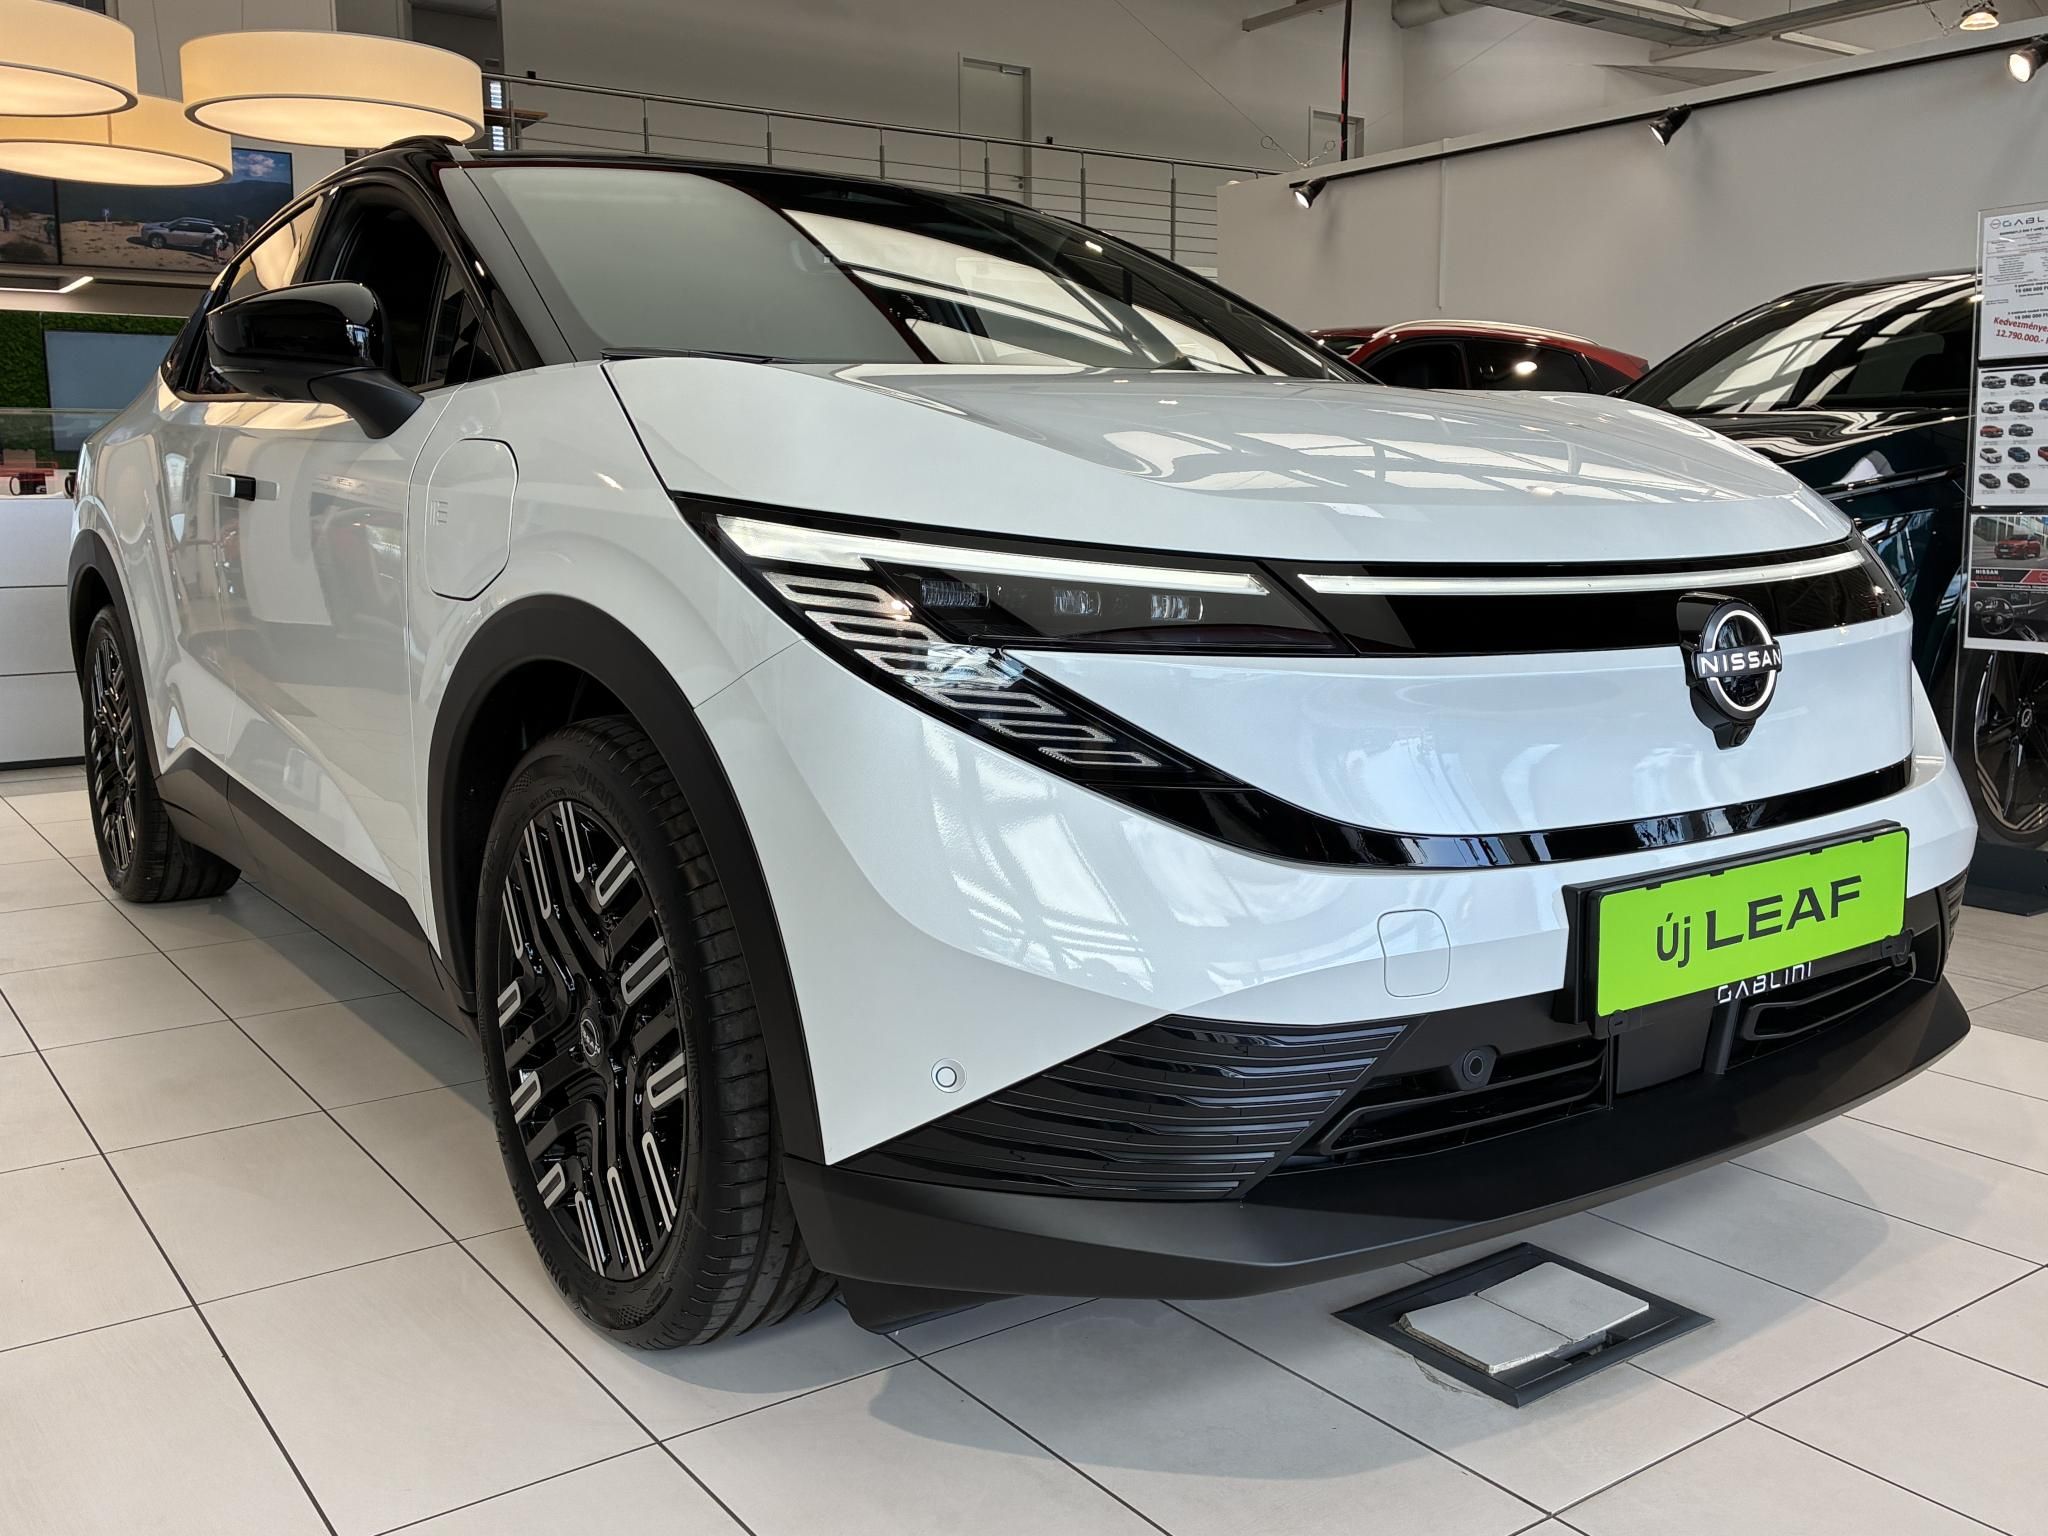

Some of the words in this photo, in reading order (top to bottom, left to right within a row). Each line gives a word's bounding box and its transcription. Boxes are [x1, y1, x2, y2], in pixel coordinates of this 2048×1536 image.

[1993, 316, 2048, 333] Kedvezménye
[1700, 649, 1782, 674] NISSAN
[1705, 875, 1862, 951] LEAF
[1717, 961, 1812, 1004] GABLINI
